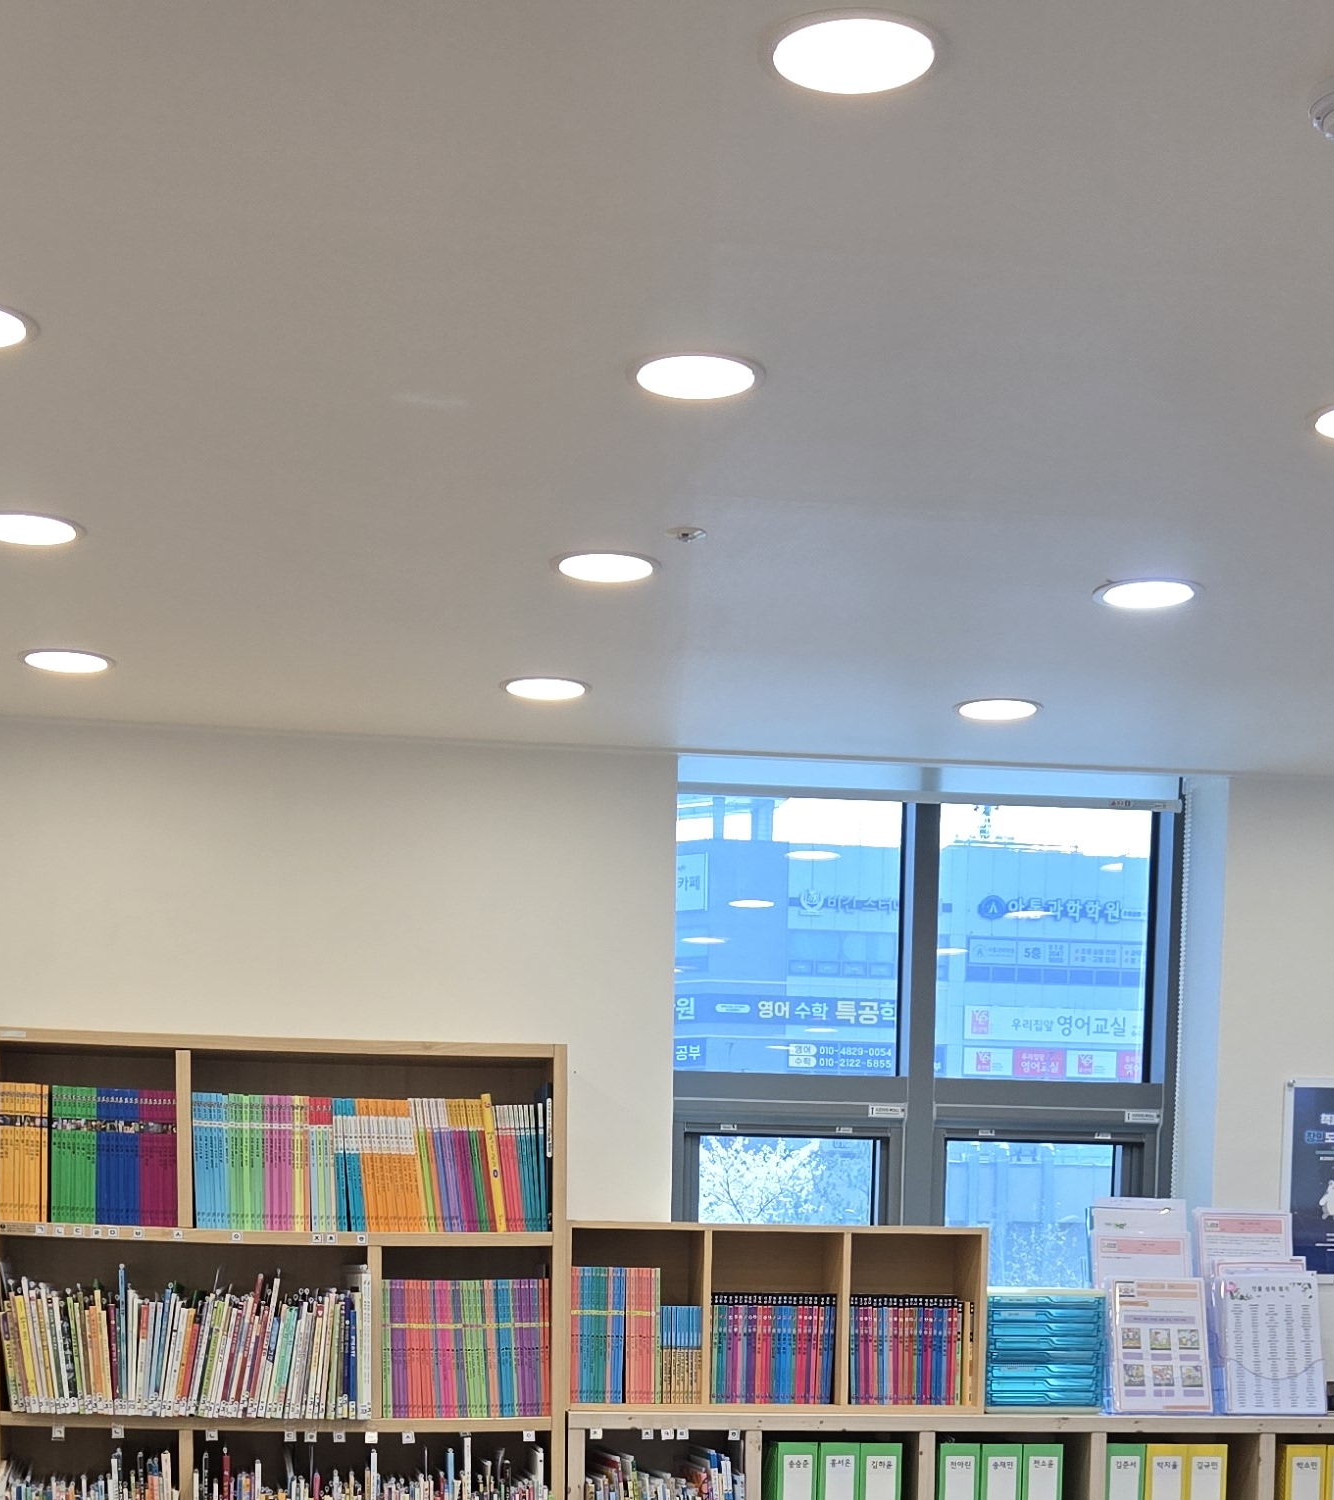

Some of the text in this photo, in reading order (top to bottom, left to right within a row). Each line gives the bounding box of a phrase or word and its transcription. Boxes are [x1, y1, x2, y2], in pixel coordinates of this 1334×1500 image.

[674, 997, 695, 1020] 원
[758, 1001, 789, 1018] 영어
[795, 1003, 828, 1020] 수학
[1011, 1018, 1054, 1032] 우리집앞
[1057, 1015, 1126, 1037] 영어교실
[676, 1045, 701, 1061] 공부
